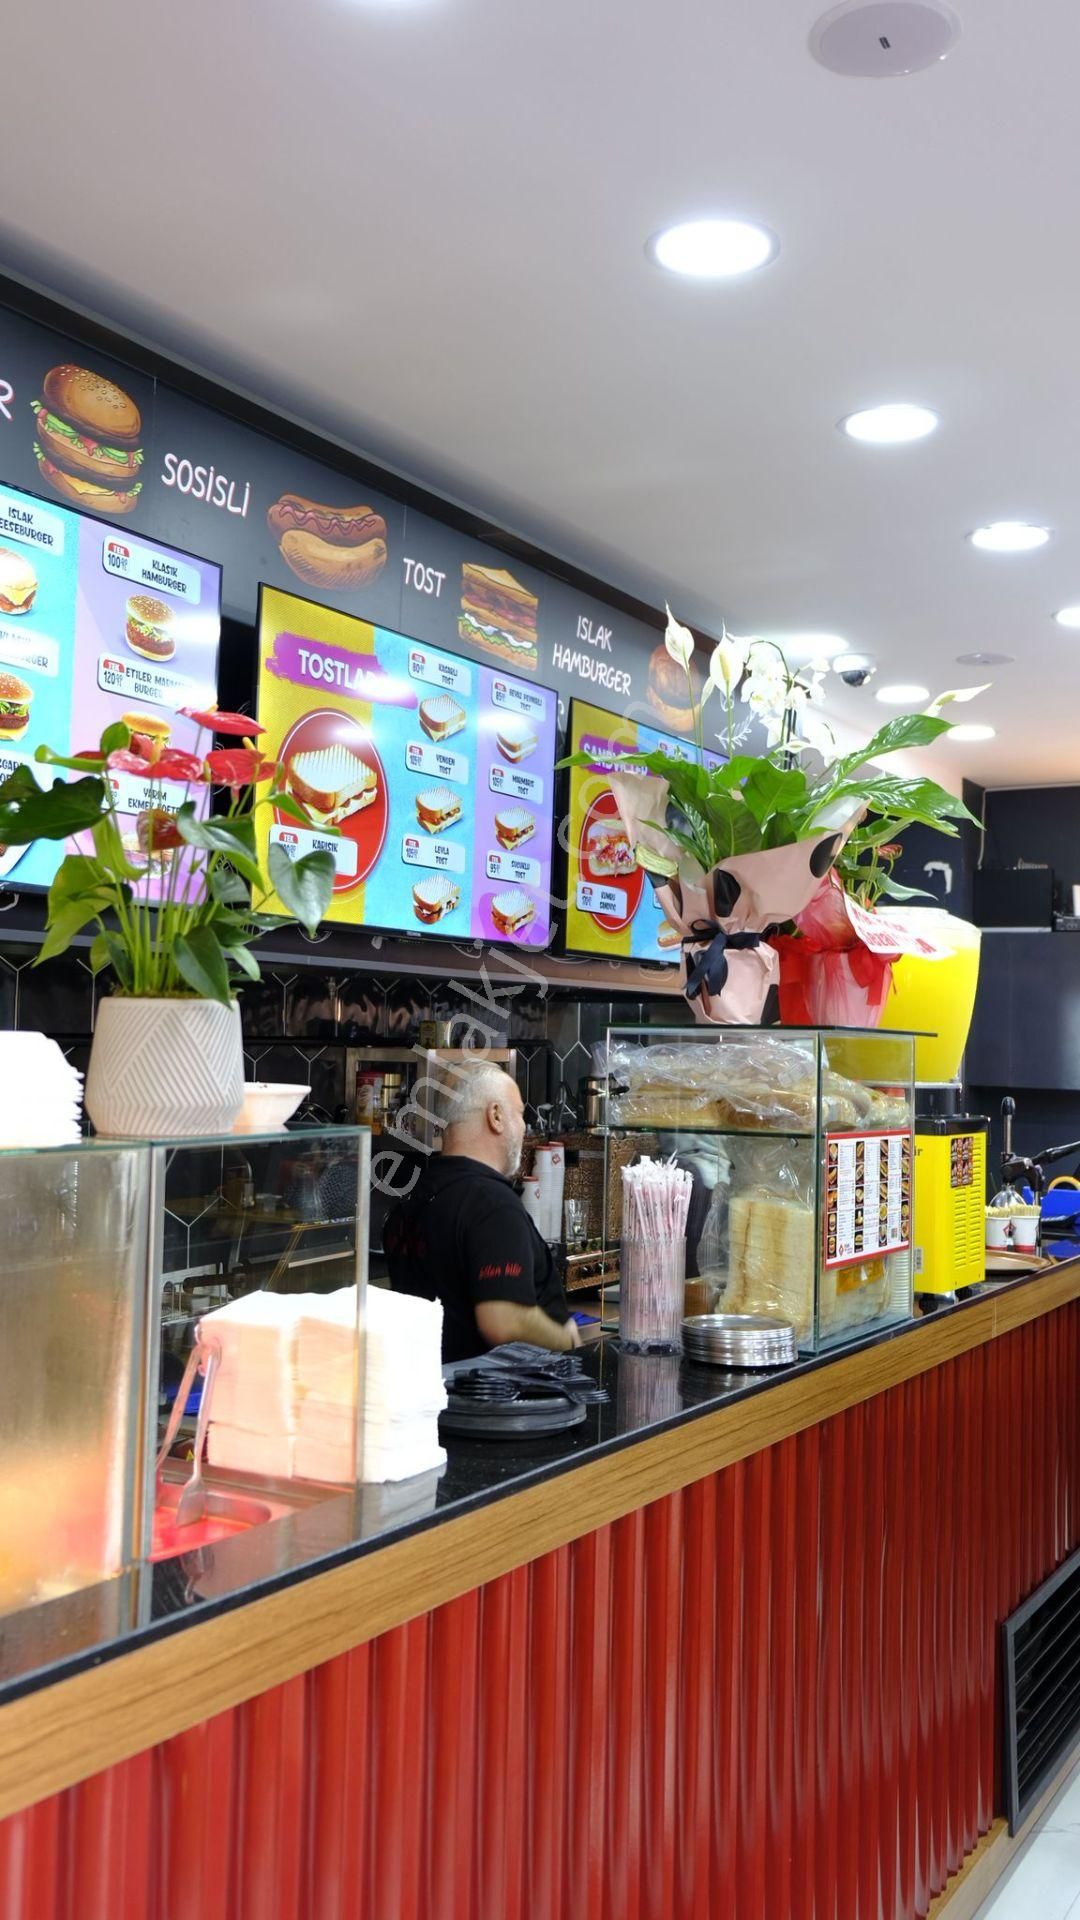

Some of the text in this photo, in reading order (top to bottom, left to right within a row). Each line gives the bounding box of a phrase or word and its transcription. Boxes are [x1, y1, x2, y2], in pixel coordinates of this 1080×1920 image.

[161, 453, 250, 517] SOSİSLİ
[8, 507, 34, 525] ISLAK
[142, 568, 187, 594] HAMBURGER
[403, 557, 446, 598] TOST
[576, 615, 612, 652] ISLAK
[552, 644, 632, 696] HAMBURGER
